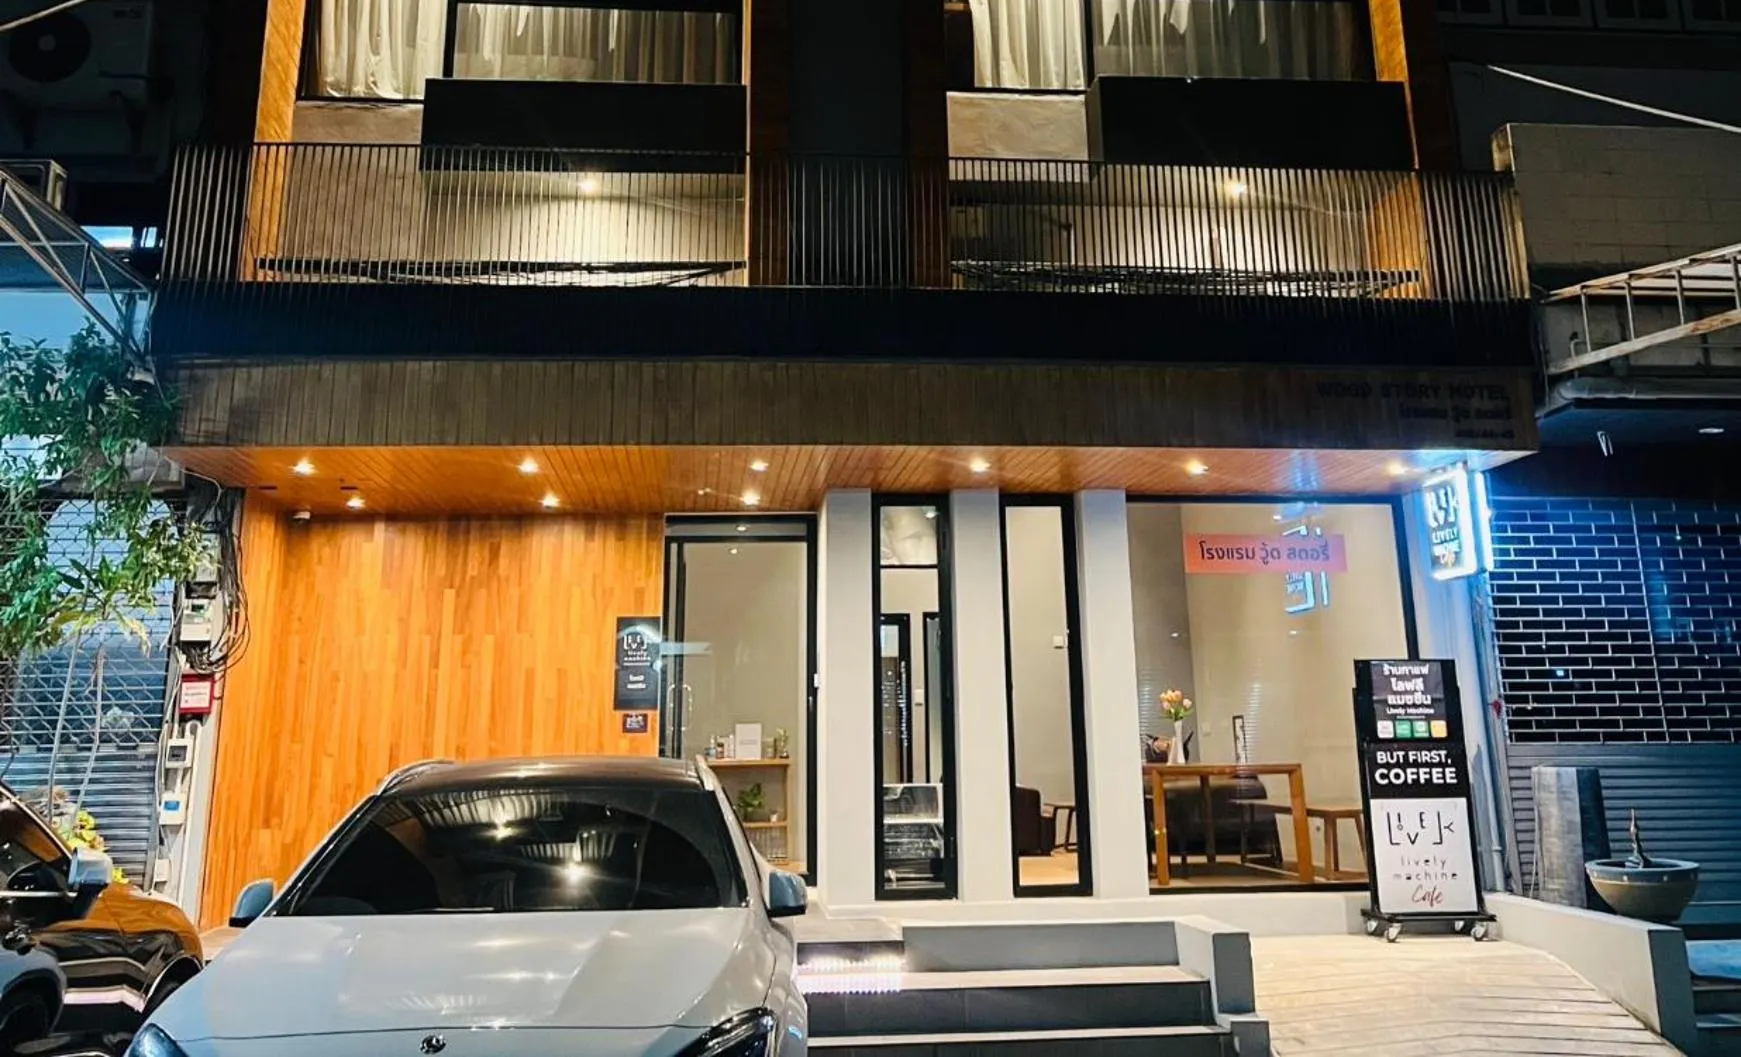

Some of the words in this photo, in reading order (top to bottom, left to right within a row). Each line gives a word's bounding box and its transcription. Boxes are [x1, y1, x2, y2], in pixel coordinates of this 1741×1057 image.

[1316, 382, 1372, 399] WOOD
[1381, 382, 1441, 399] STORY
[1199, 541, 1255, 562] โรงแรม
[1259, 542, 1281, 565] วู้ด
[1376, 751, 1405, 764] BUT
[1408, 750, 1452, 764] FIRST,
[1374, 767, 1458, 785] COFFEE
[1401, 856, 1447, 867] lively
[1393, 871, 1458, 881] machine
